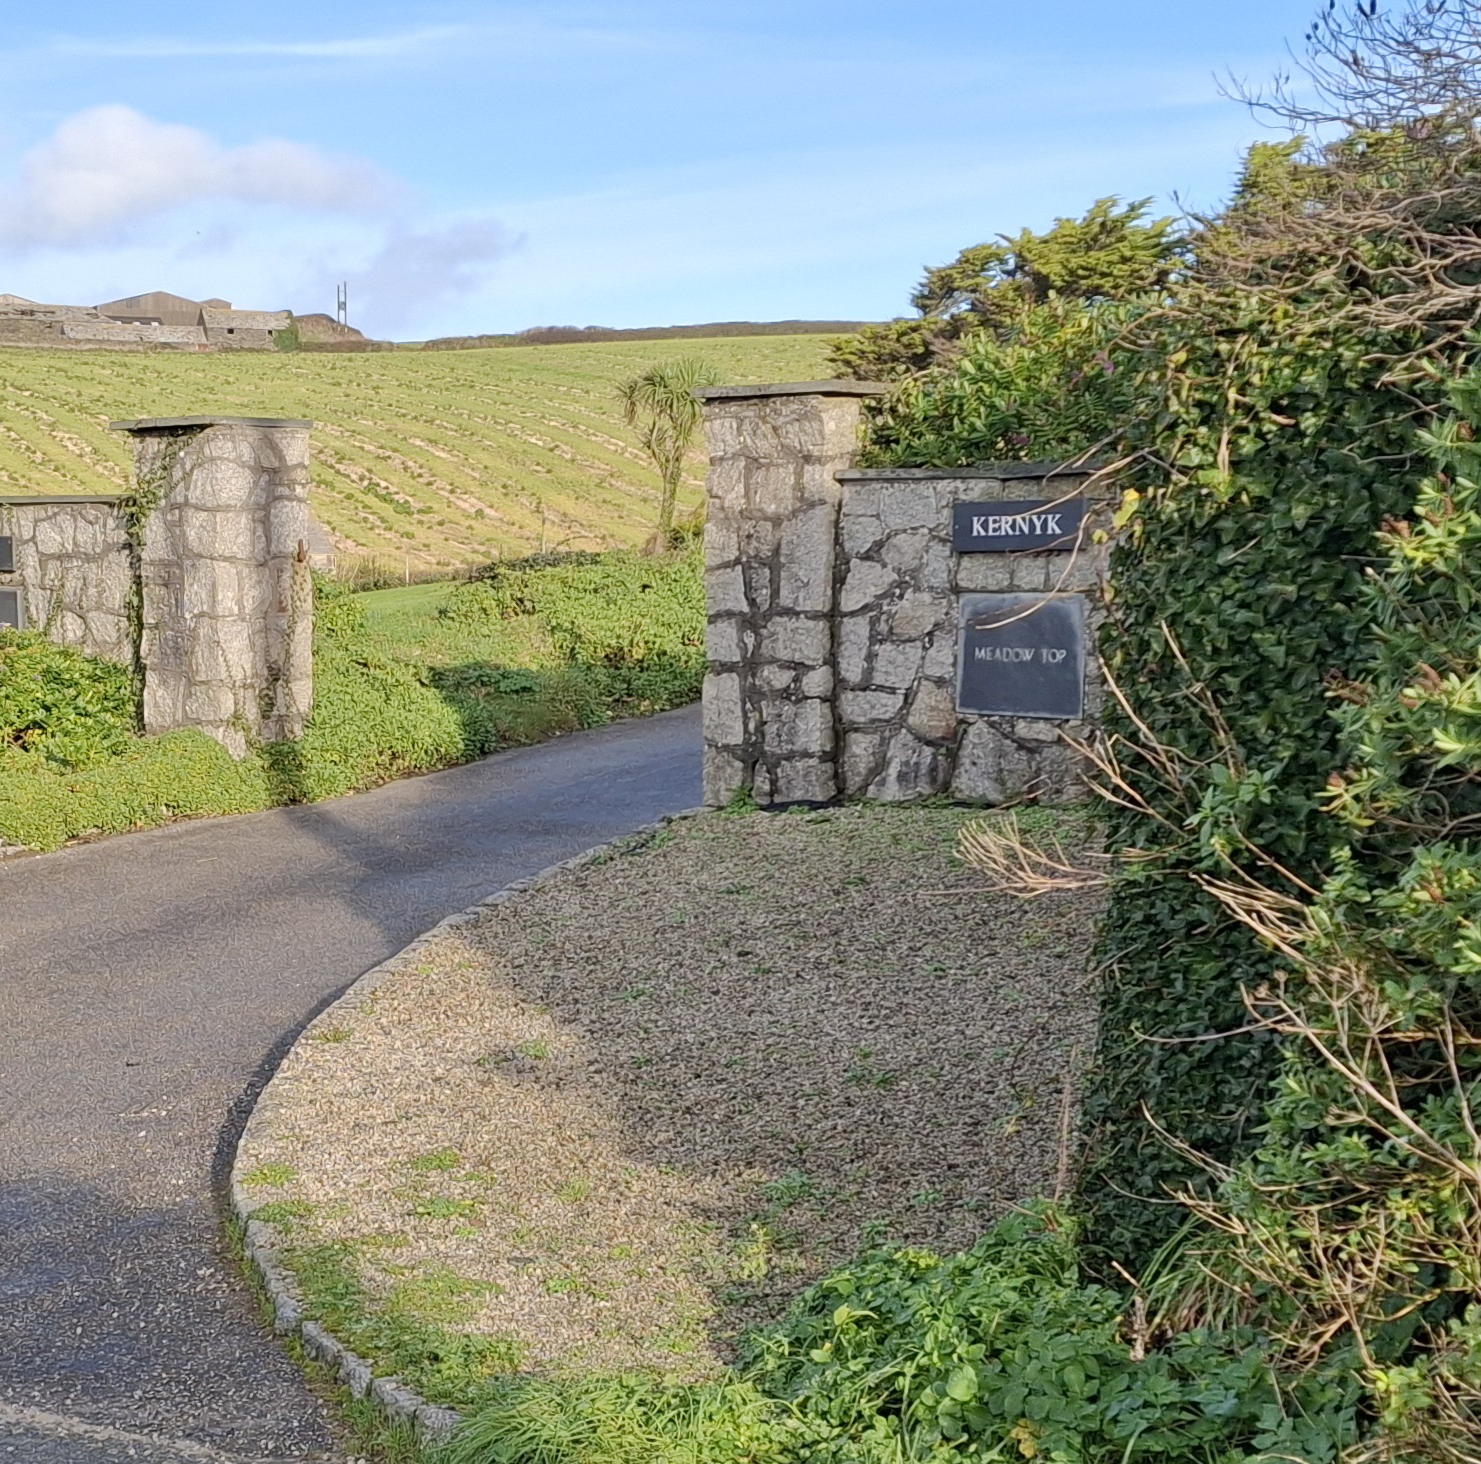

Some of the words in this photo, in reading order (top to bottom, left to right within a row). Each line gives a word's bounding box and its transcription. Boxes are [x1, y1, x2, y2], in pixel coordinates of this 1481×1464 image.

[972, 514, 1063, 537] KERNYK
[974, 646, 1035, 662] MEADOW
[1042, 648, 1068, 664] TOP
